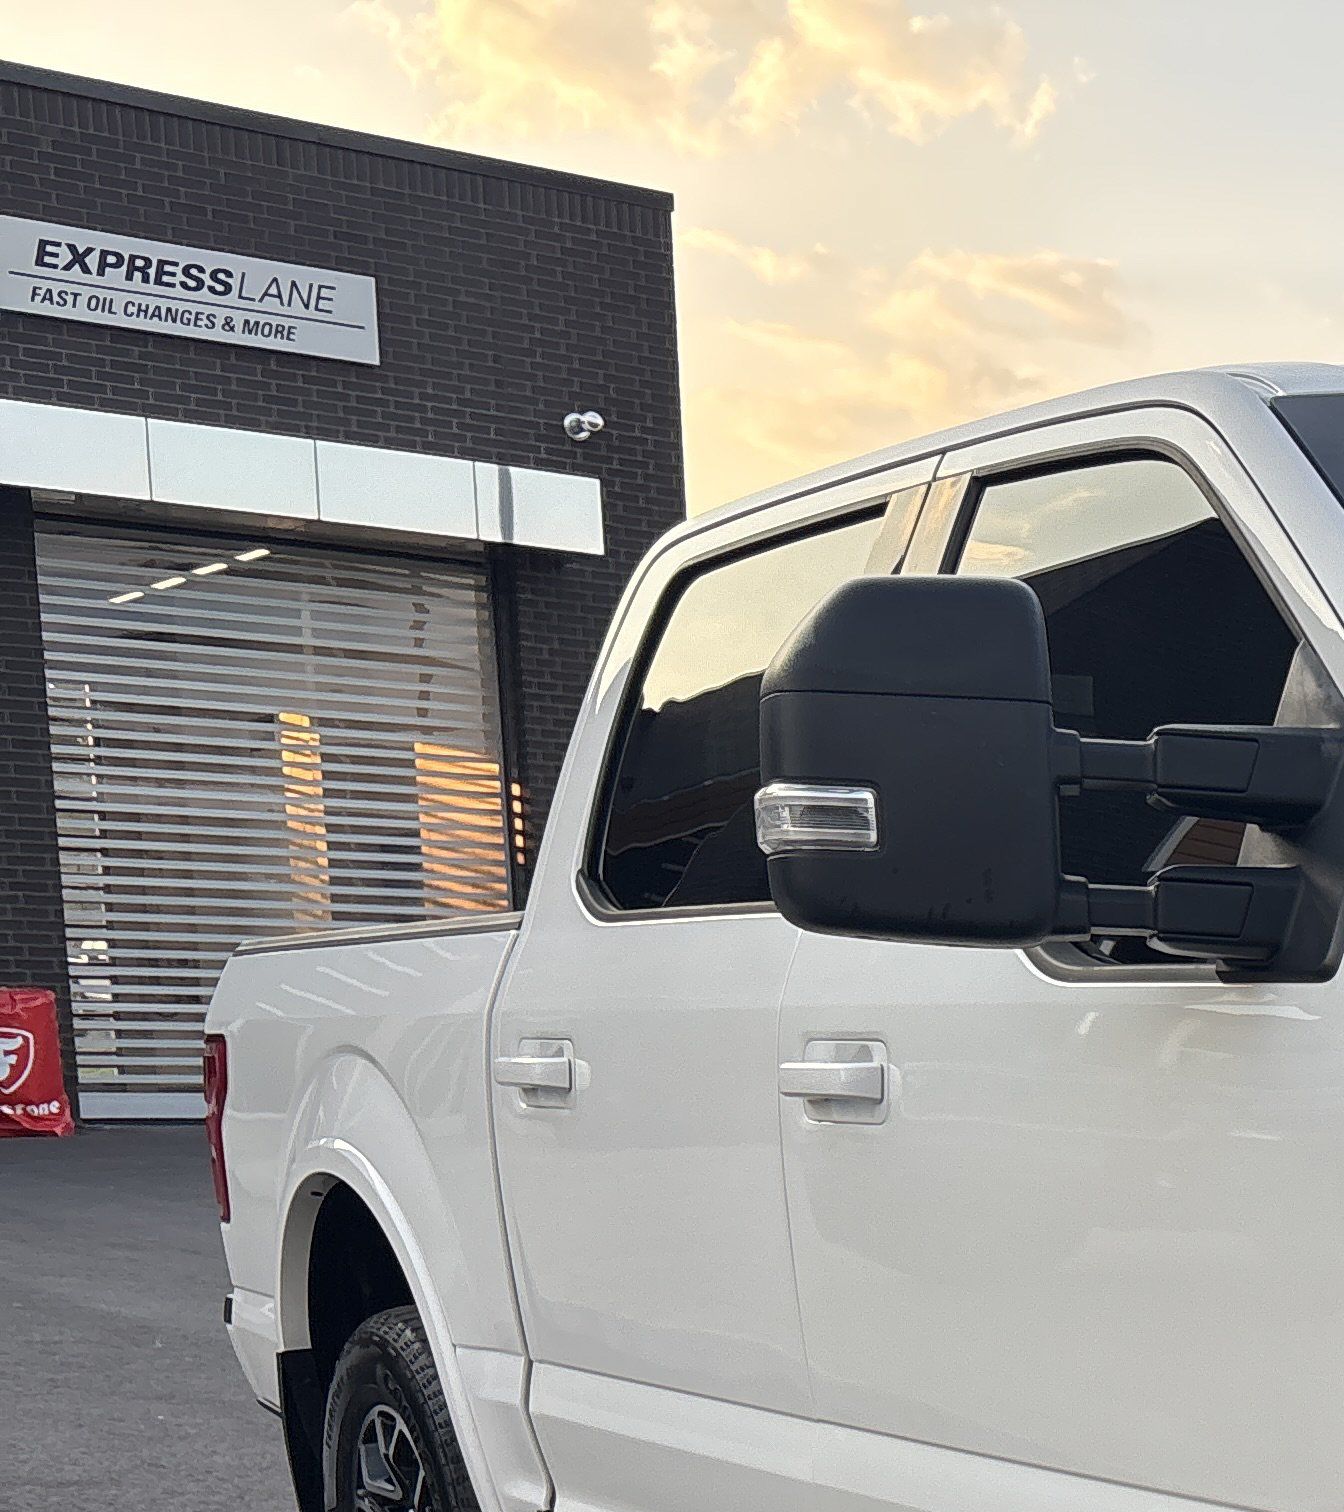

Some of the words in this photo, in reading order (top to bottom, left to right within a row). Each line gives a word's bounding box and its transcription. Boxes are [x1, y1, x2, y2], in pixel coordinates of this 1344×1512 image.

[30, 285, 82, 309] FAST
[86, 294, 117, 315] OIL
[123, 299, 217, 330] CHANGES
[221, 316, 237, 333] &
[241, 319, 298, 342] MORE
